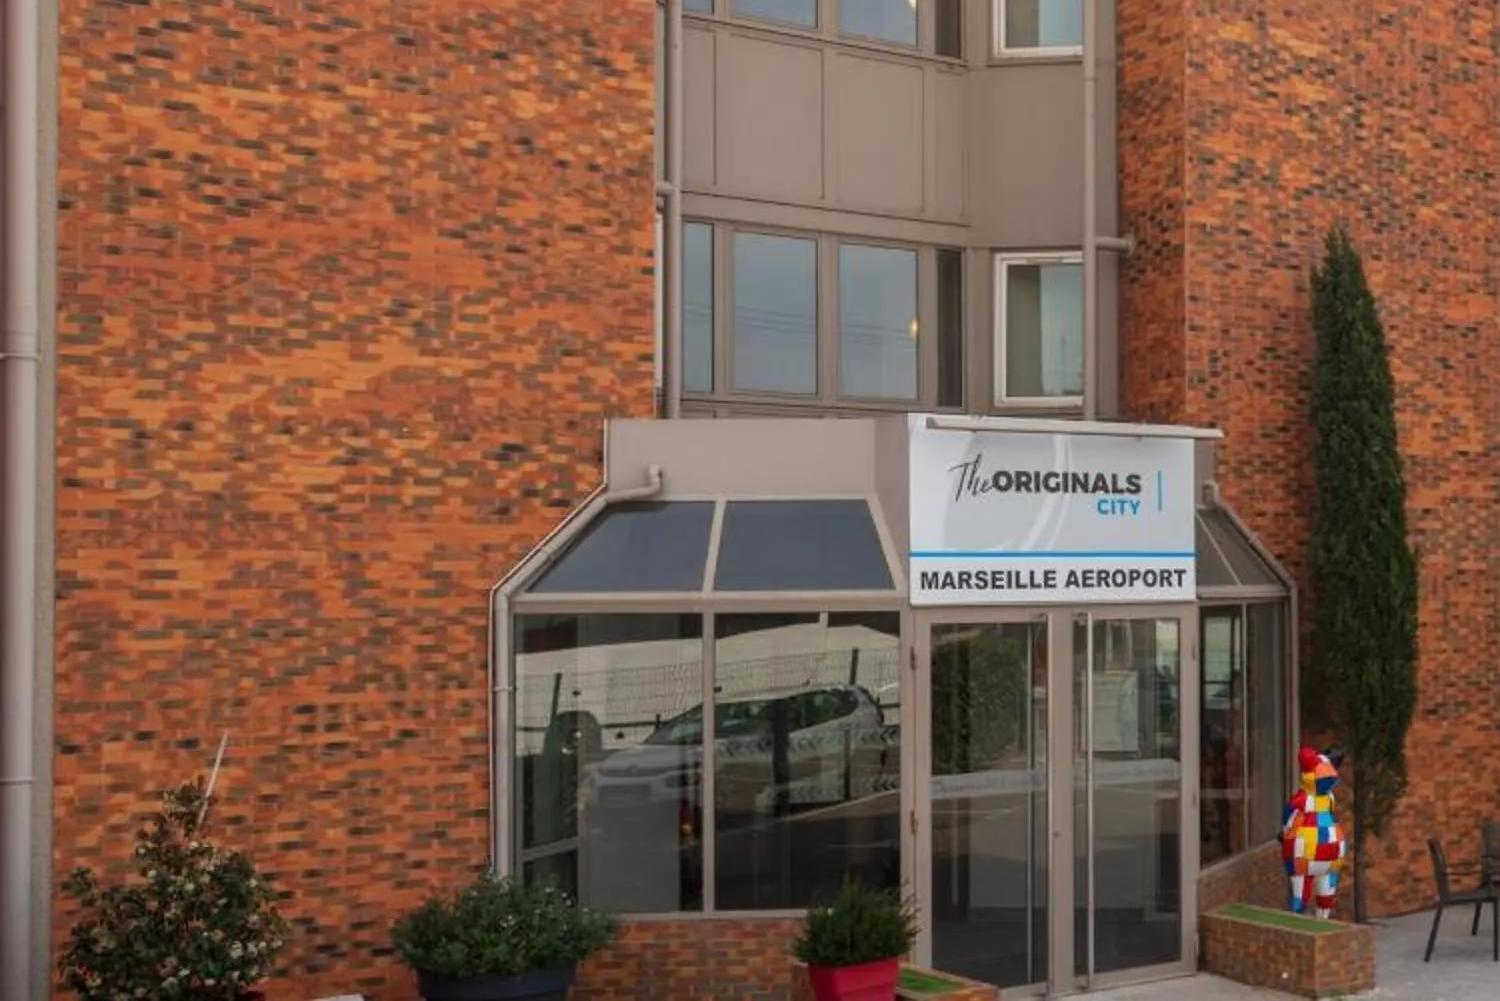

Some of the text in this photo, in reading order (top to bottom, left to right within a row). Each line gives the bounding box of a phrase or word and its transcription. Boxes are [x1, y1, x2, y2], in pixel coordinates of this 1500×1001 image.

[1096, 499, 1142, 516] CITY
[920, 568, 1188, 591] MARSEILLE AEROPORT
